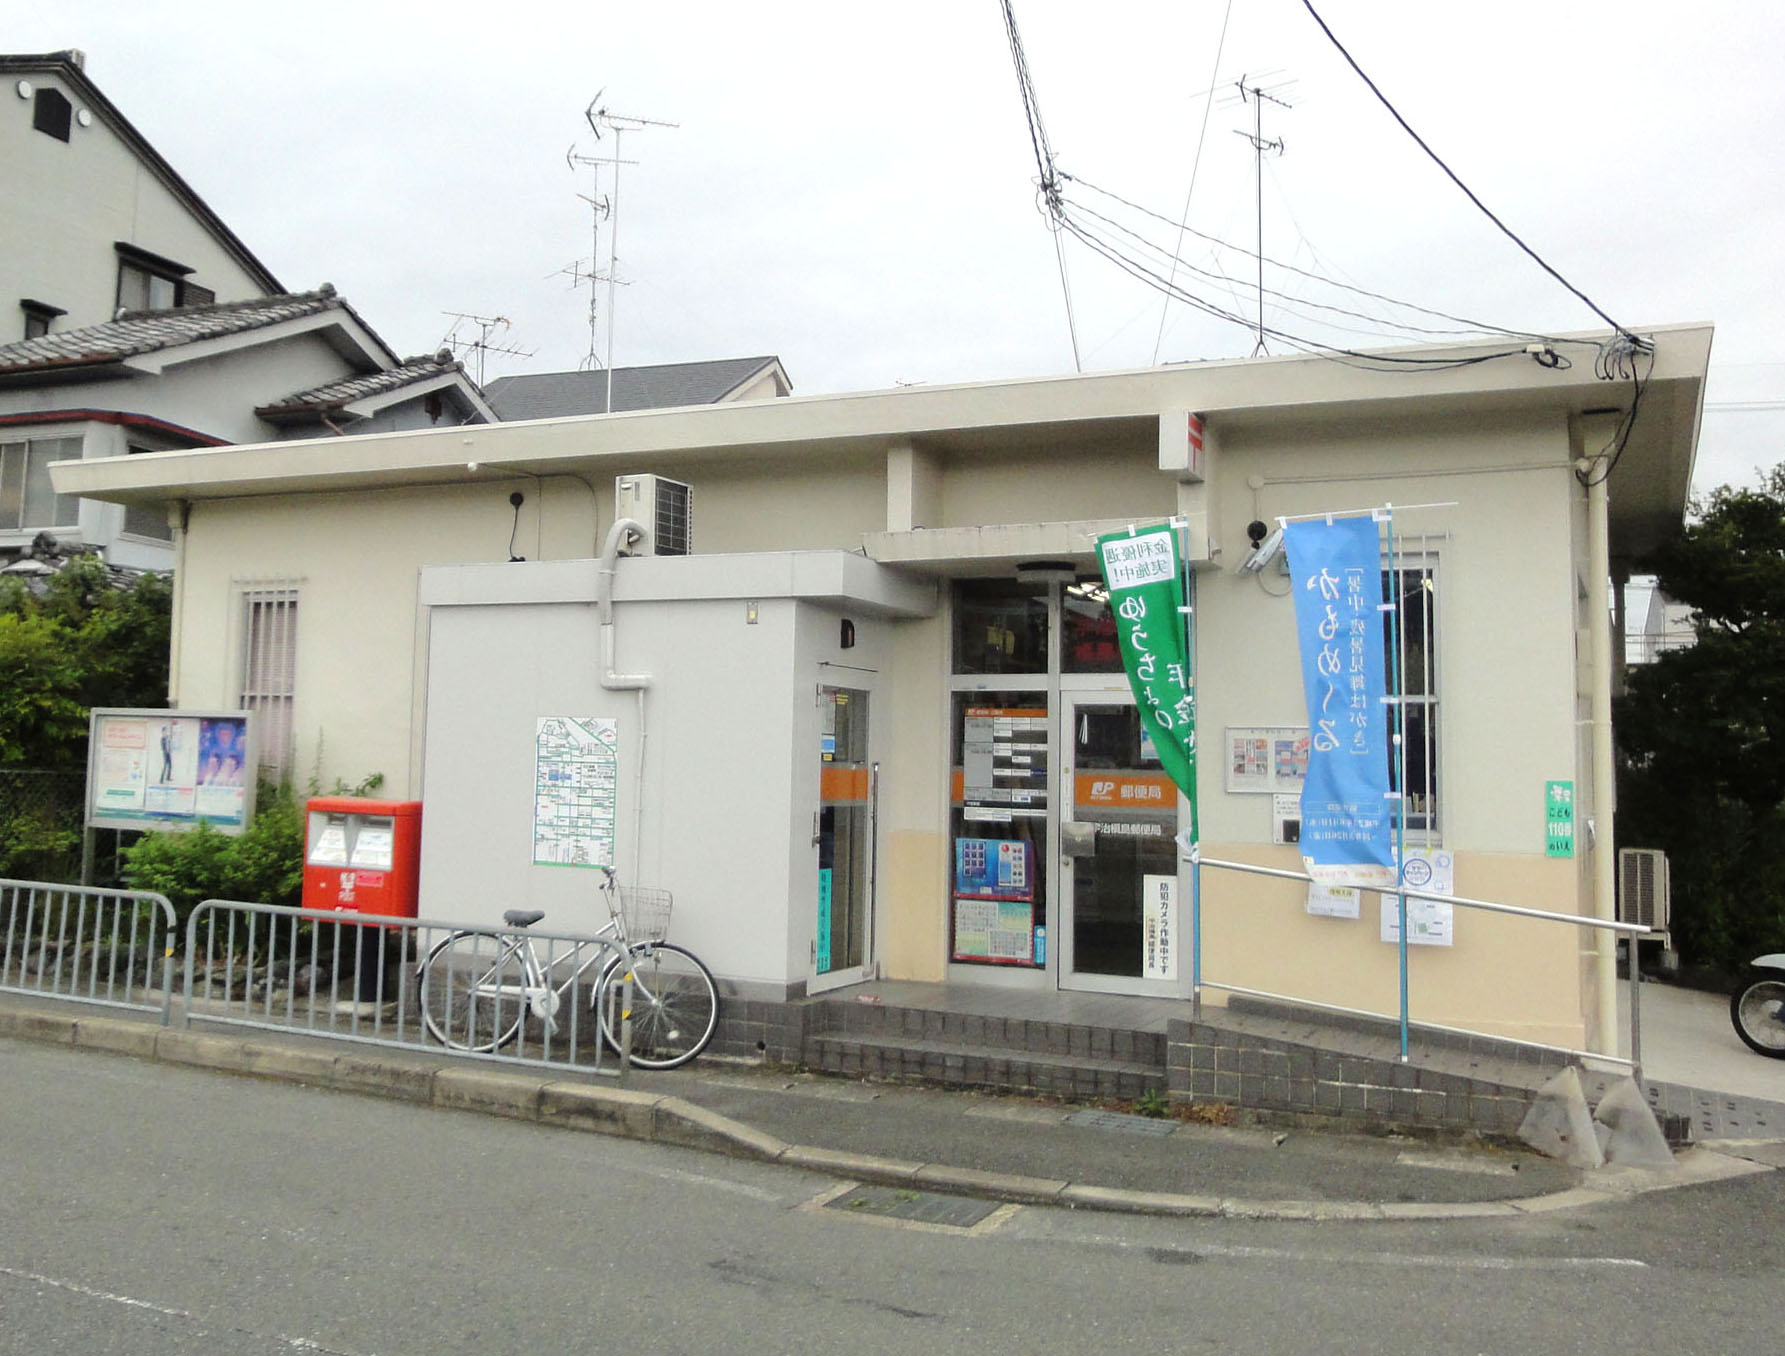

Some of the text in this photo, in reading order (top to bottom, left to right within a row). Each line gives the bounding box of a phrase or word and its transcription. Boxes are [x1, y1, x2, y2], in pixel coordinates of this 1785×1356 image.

[1120, 784, 1162, 799] 郵便局
[1549, 807, 1571, 818] こども
[1548, 822, 1572, 837] 110番
[1160, 882, 1169, 975] 防犯カメラ作動中です
